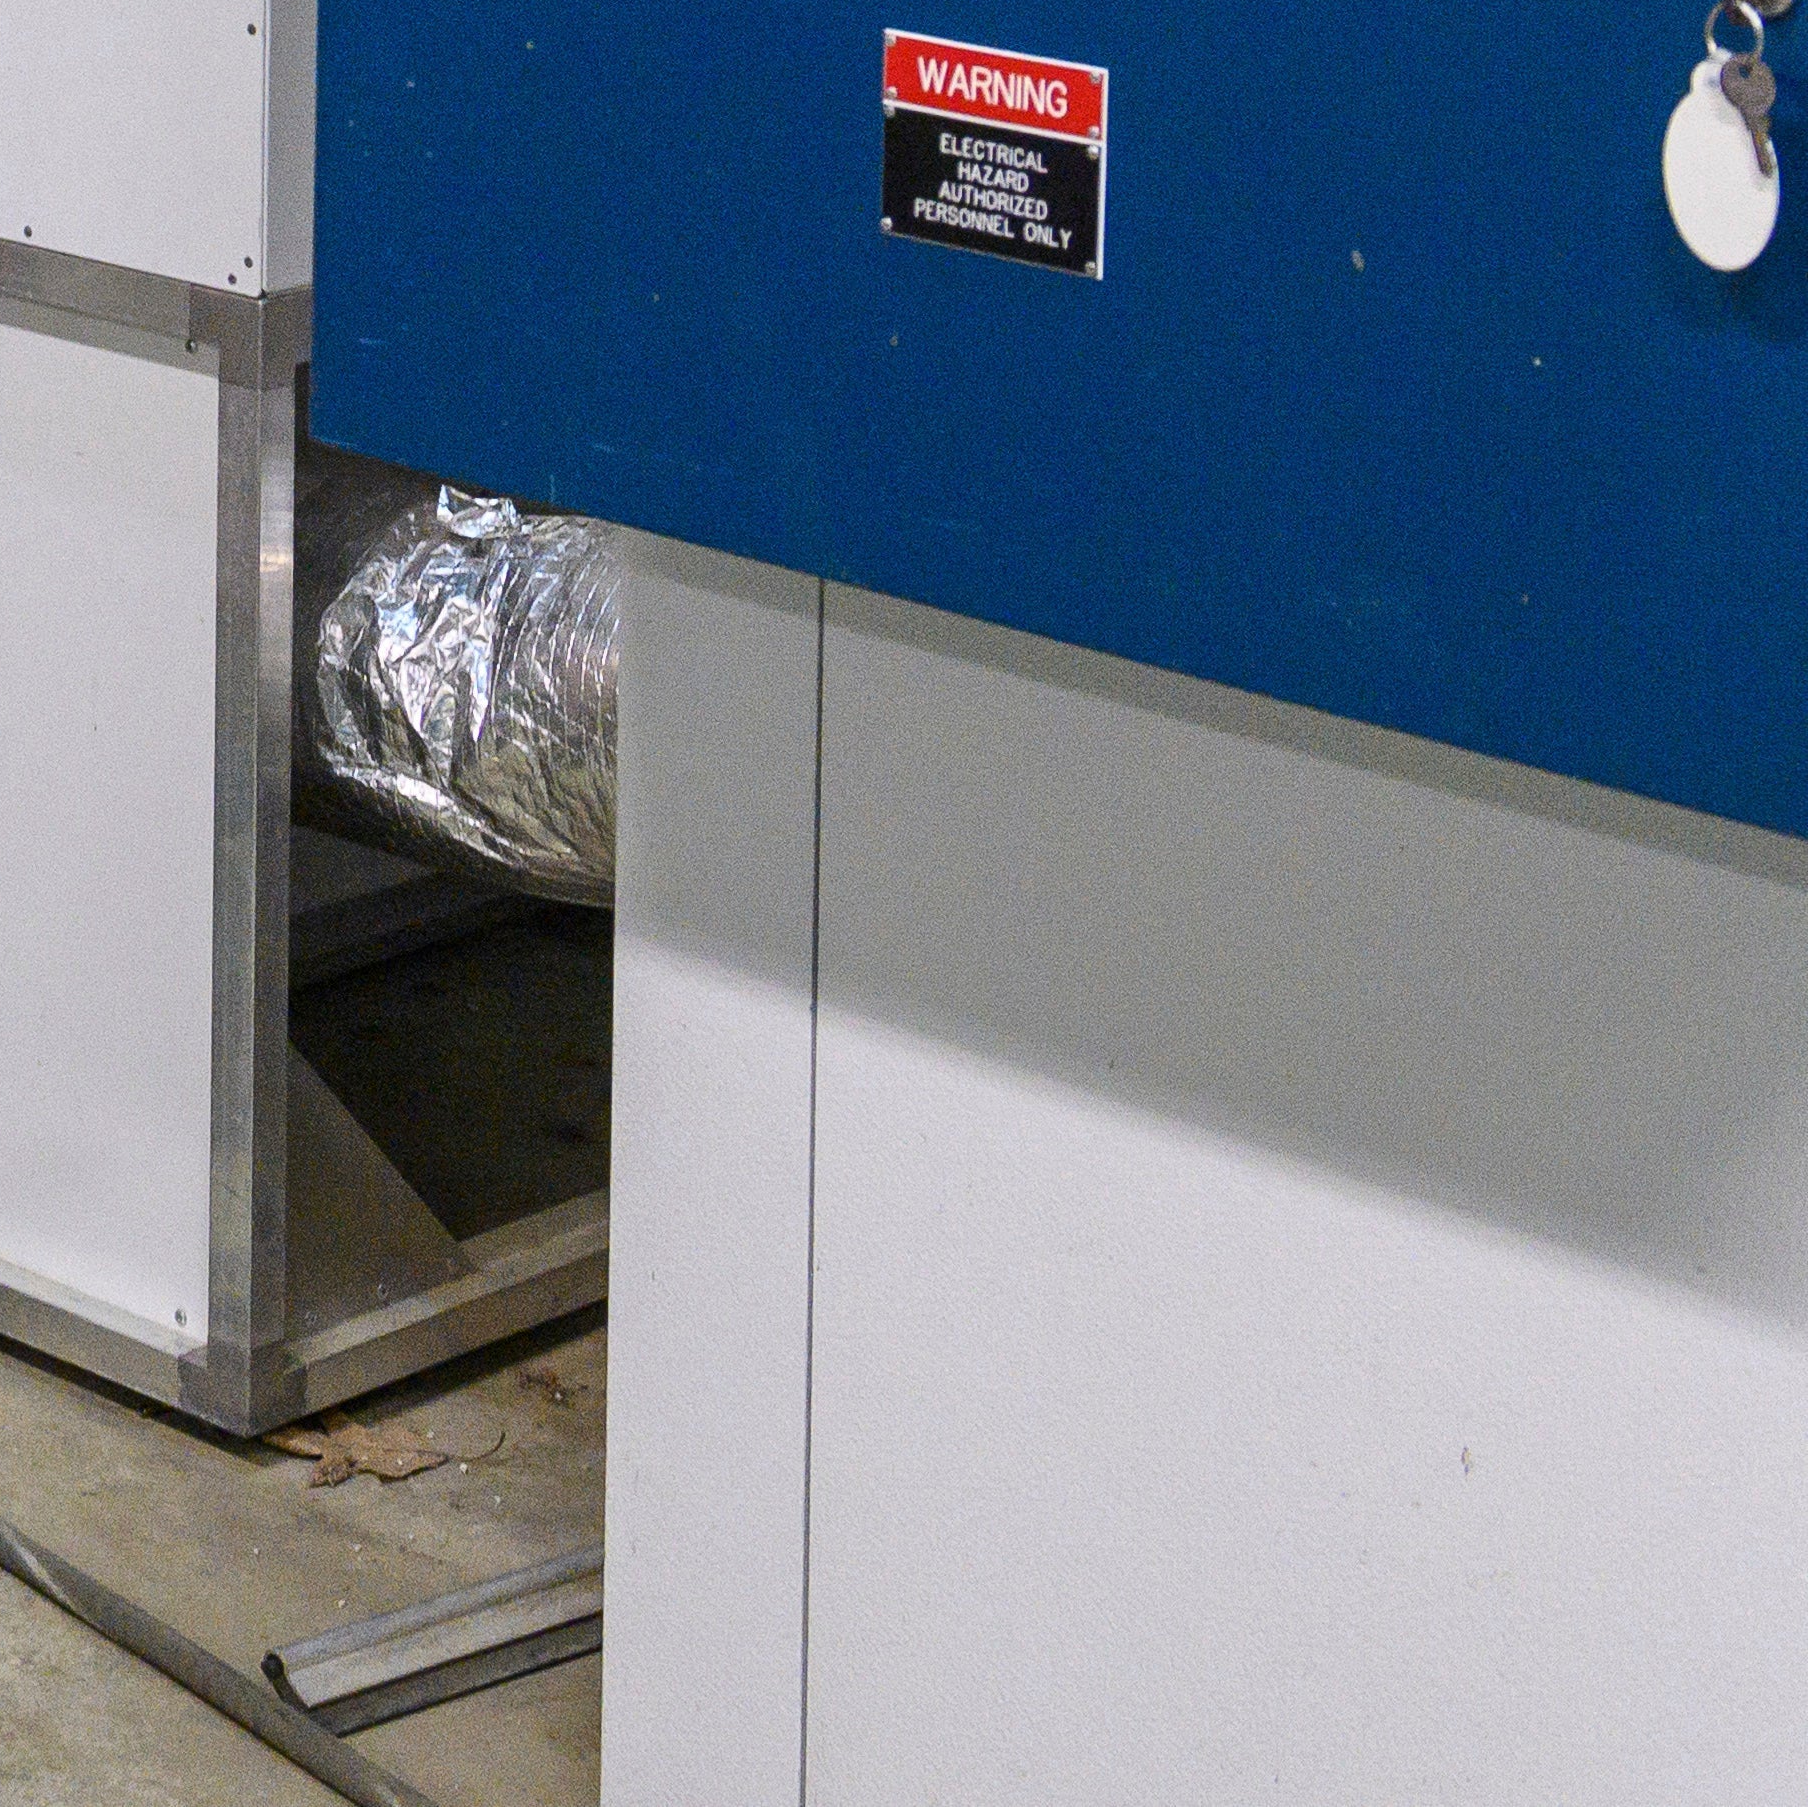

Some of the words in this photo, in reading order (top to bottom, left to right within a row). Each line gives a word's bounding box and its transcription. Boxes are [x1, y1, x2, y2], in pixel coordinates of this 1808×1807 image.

[917, 56, 1067, 118] WARNING
[938, 132, 1048, 174] ELECTRICAL
[957, 161, 1029, 193] HAZARD
[938, 180, 1048, 220] AUTHORIZED
[913, 197, 1015, 239] PERSONNEL
[1023, 222, 1072, 250] ONLY
